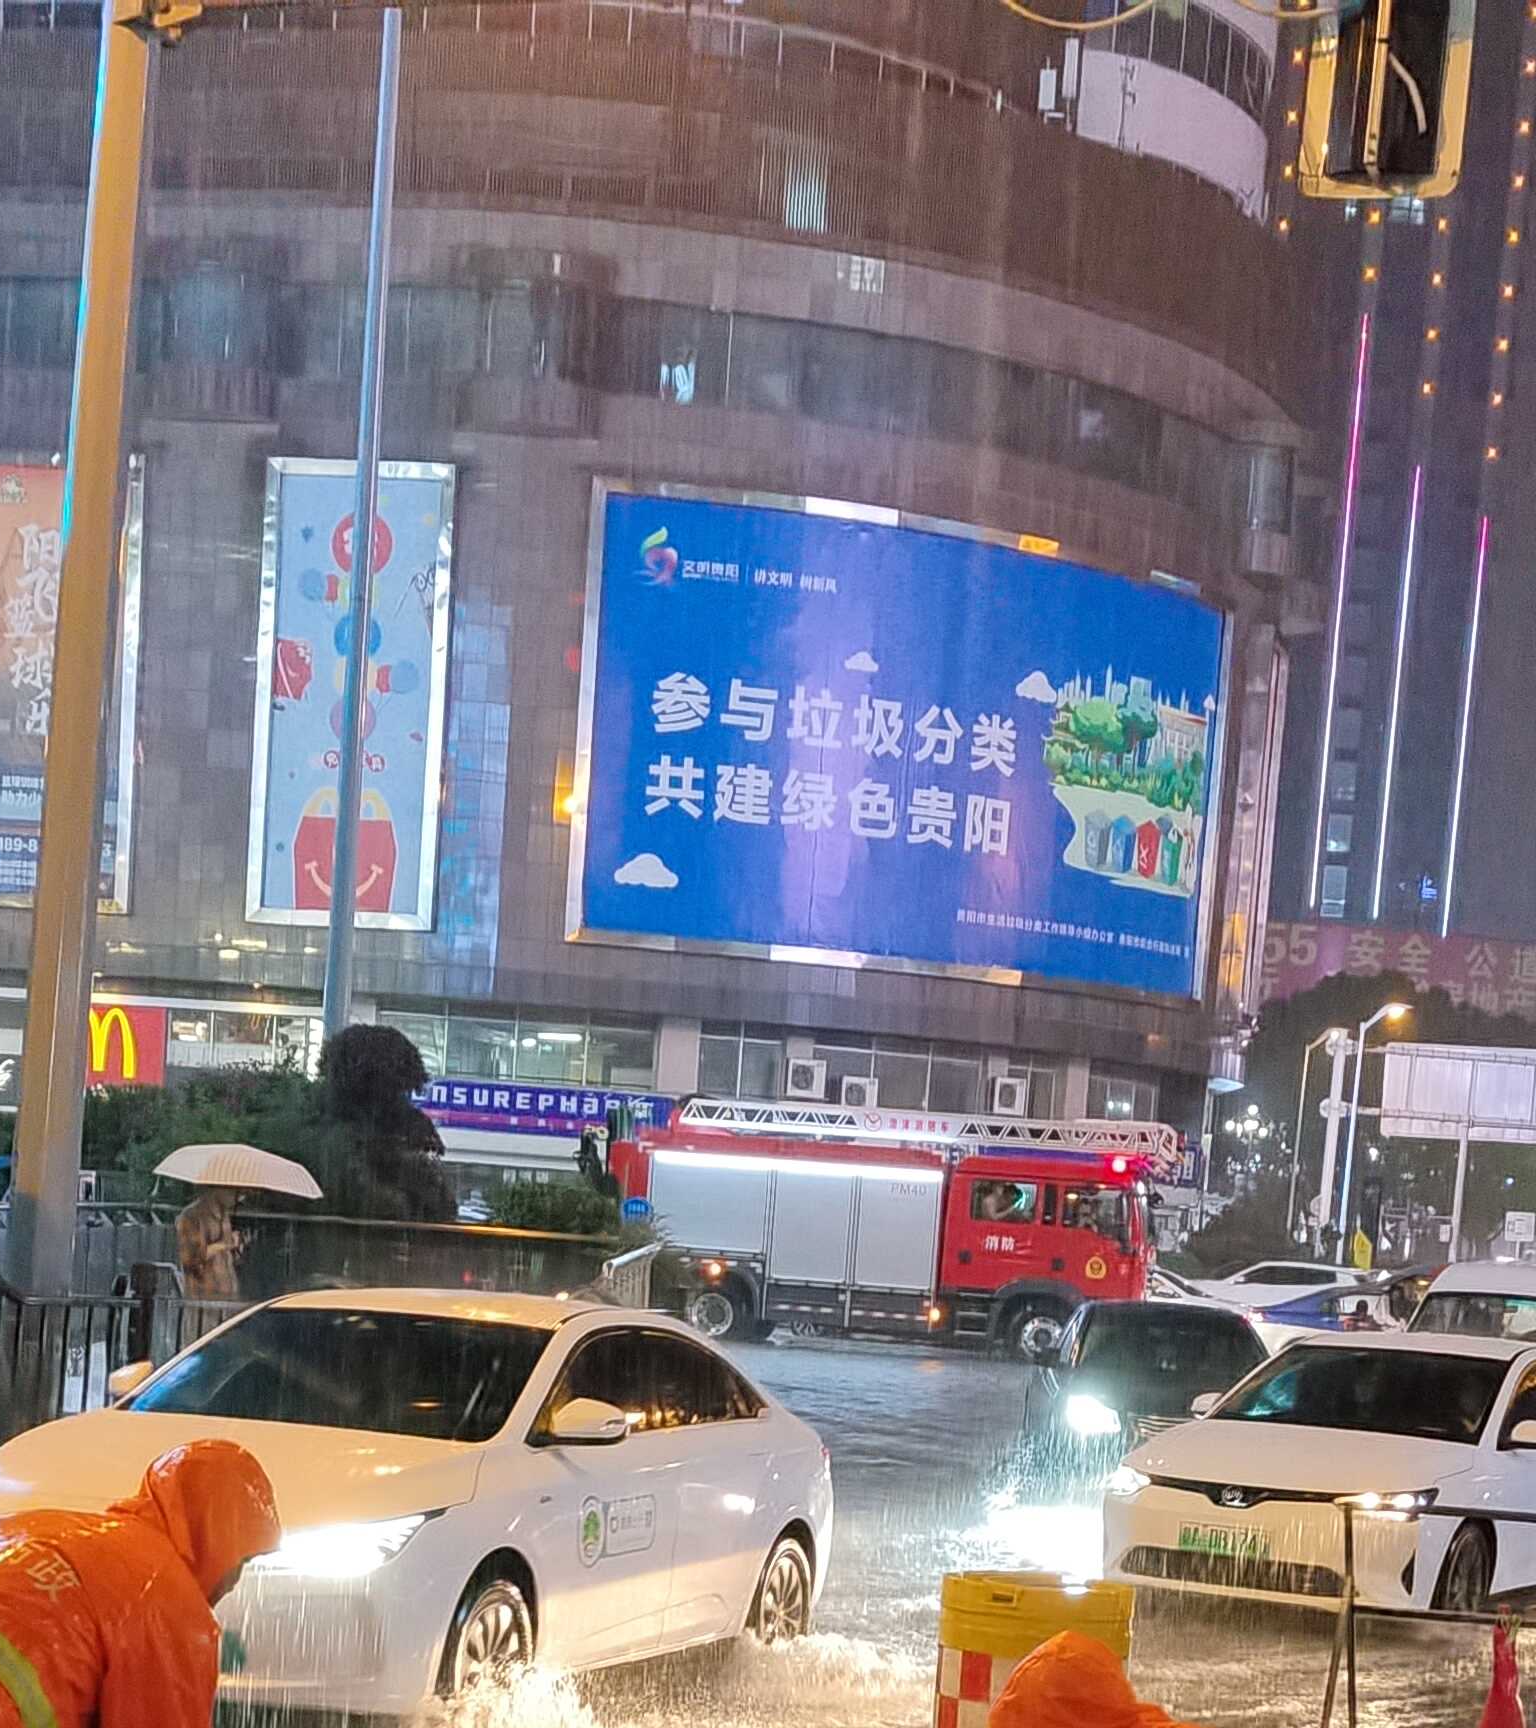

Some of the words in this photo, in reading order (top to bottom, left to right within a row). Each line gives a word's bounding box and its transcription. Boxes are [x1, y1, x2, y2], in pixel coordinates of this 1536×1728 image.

[650, 671, 1018, 778] 参与垃圾分类
[643, 754, 1013, 857] 共建绿色贵阳
[1348, 927, 1433, 977] 安全
[984, 1234, 1015, 1252] 消防
